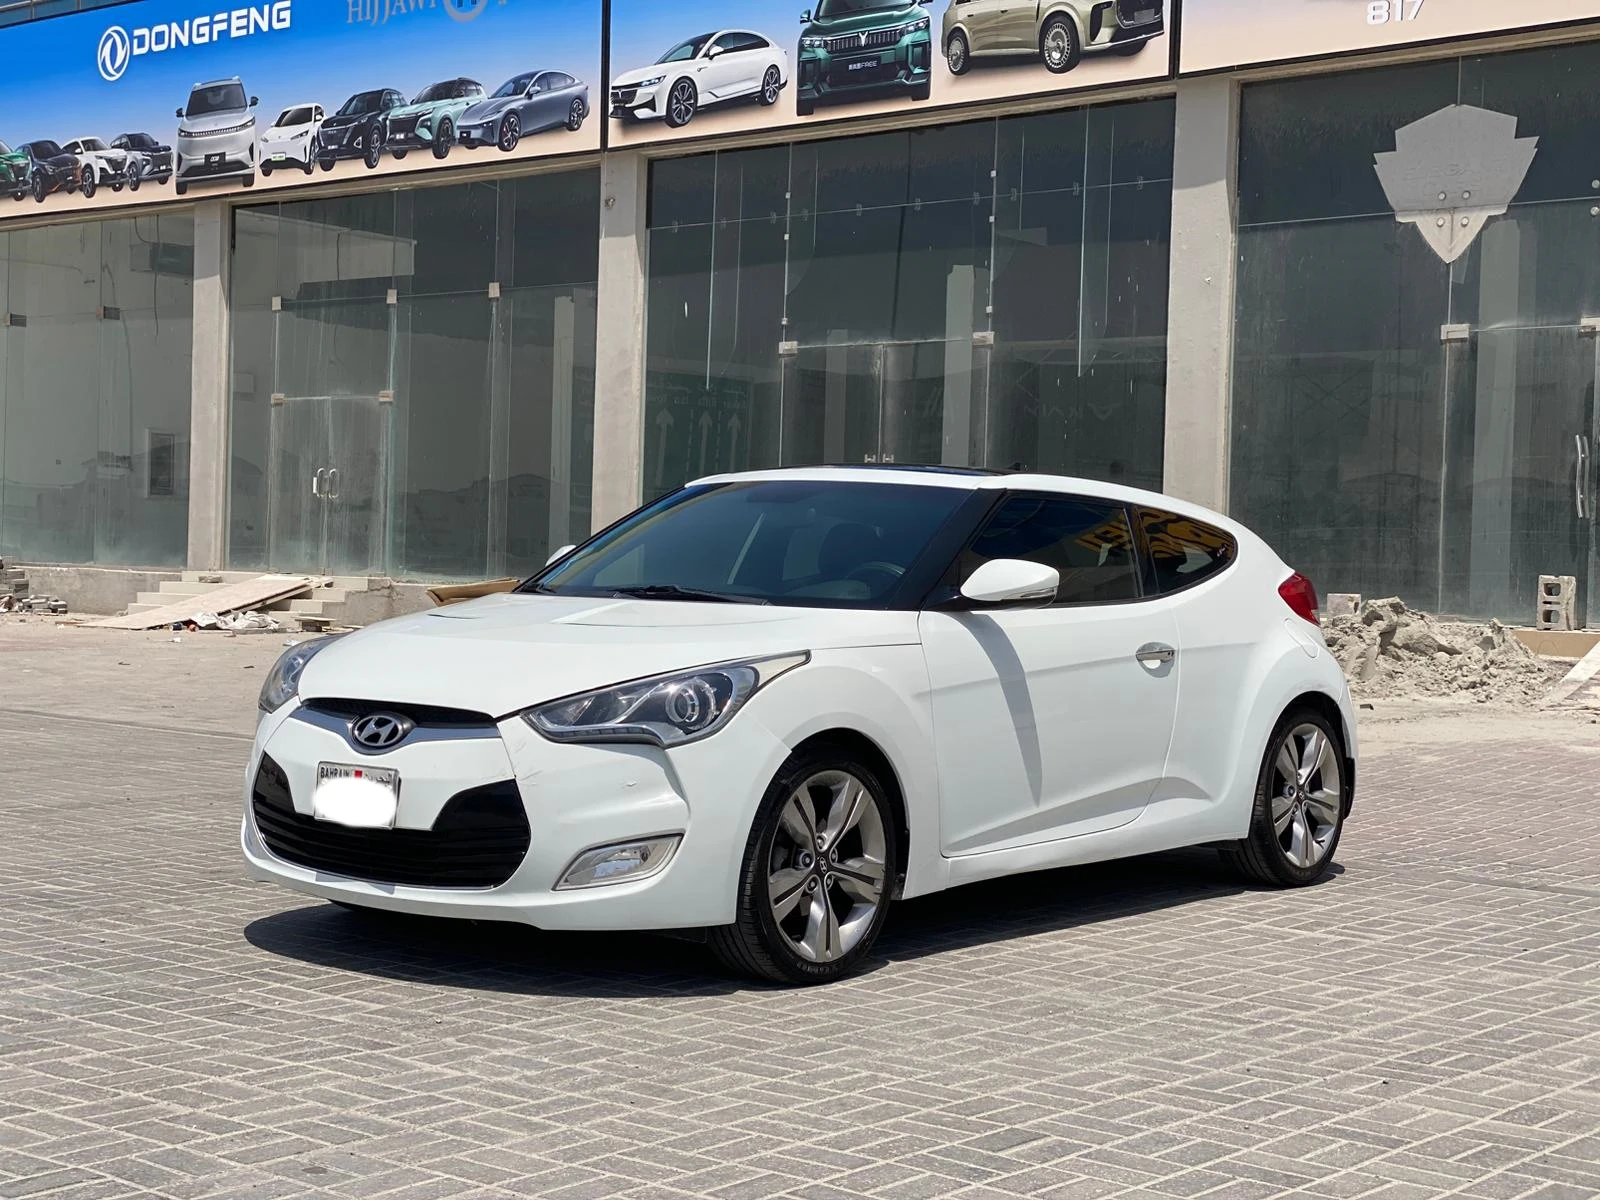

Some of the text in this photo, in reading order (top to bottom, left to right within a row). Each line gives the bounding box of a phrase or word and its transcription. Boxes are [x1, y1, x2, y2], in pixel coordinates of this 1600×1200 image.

[347, 0, 437, 25] HIJJA
[1367, 0, 1424, 25] 817
[132, 0, 291, 56] DONGFENG
[320, 767, 351, 779] BAHRAIN
